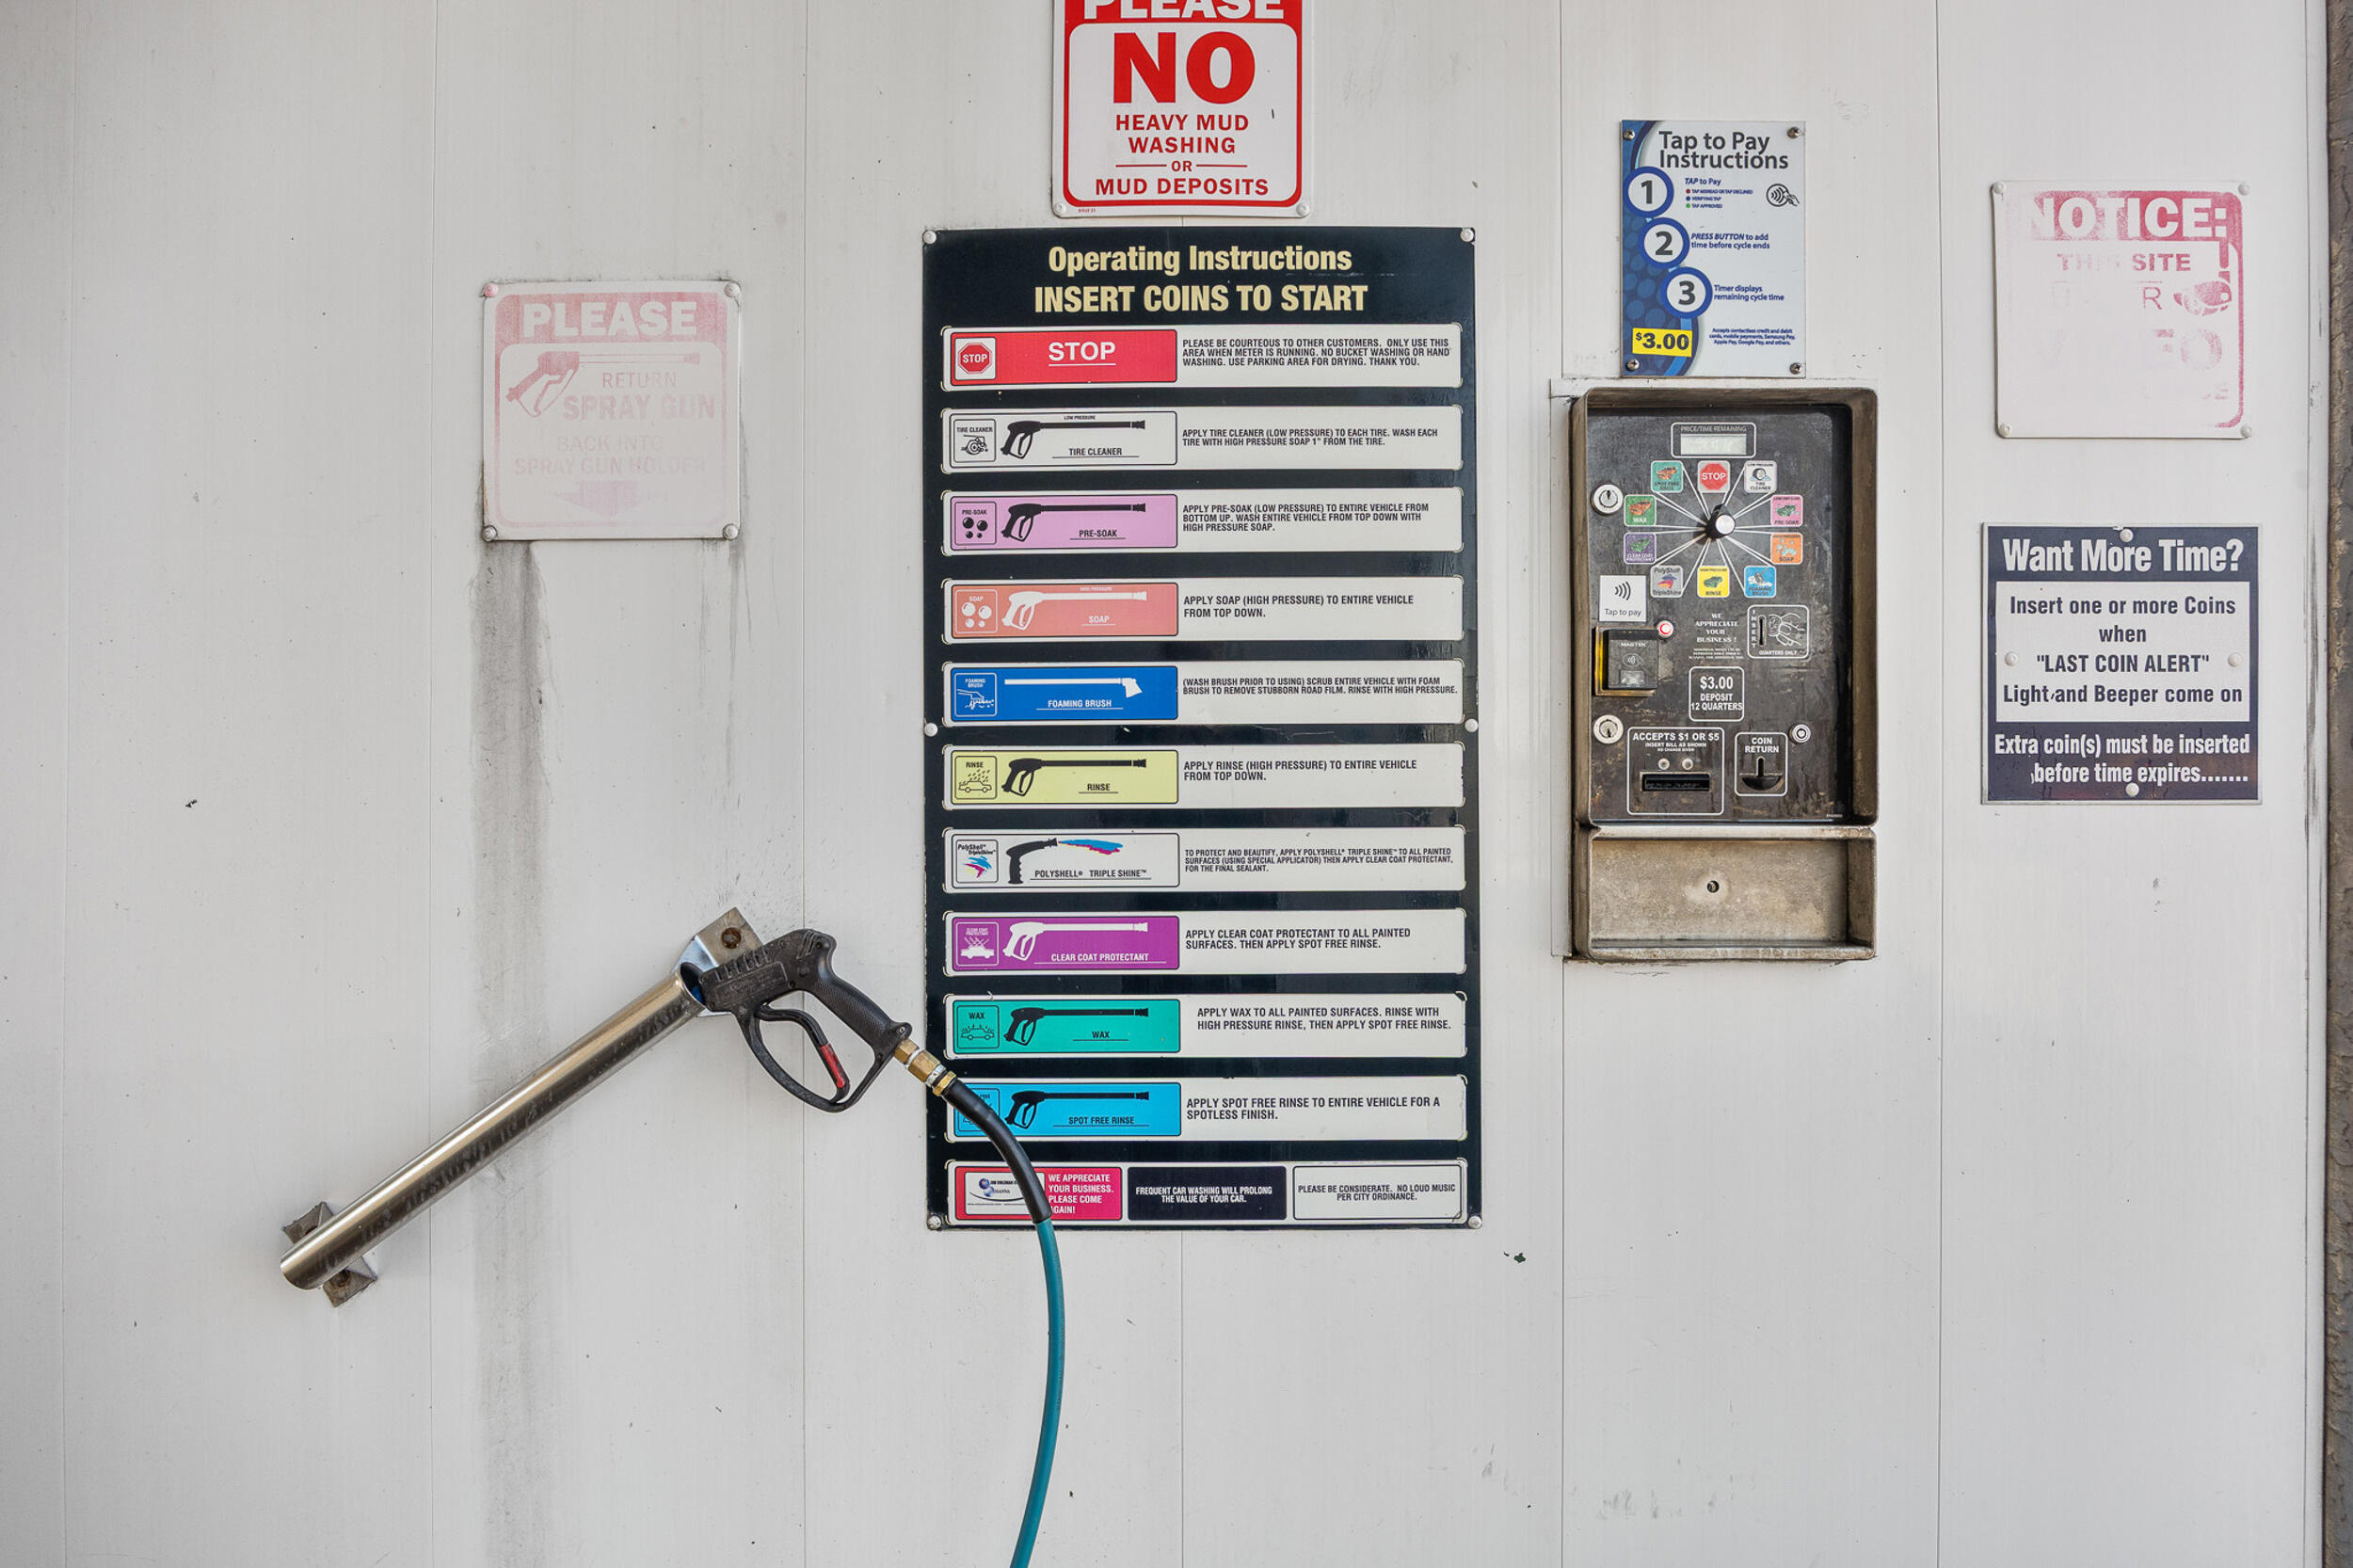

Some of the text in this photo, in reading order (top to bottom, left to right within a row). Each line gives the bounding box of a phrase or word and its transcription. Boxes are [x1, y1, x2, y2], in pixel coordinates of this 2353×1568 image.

[1113, 31, 1255, 104] NO
[1116, 115, 1248, 131] HEAVY MUD
[1129, 137, 1235, 153] WASHING
[1658, 131, 1769, 155] Tap to Pay
[1171, 161, 1192, 171] OR
[1660, 151, 1788, 169] Instructions
[1096, 178, 1268, 196] MUD DEPOSITS
[1708, 178, 1721, 186] Pay
[1641, 181, 1652, 204] 1
[1656, 232, 1673, 255] 2
[1734, 242, 1751, 250] cycle
[1048, 245, 1352, 277] Operating Instructions
[2133, 254, 2190, 271] SITE
[1035, 284, 1369, 312] INSERT COINS TO START
[1679, 280, 1695, 305] 3
[1714, 294, 1749, 302] remaining
[522, 301, 696, 337] PLEASE
[1636, 332, 1689, 350] $3.00
[963, 352, 988, 364] STOP
[1048, 342, 1115, 360] STOP
[602, 372, 677, 388] RETURN
[564, 395, 715, 421] SPRAY GUN
[2003, 538, 2244, 572] Want More Time?
[1184, 595, 1413, 606] APPLY SOAP (HIGH PRESSURE) TO ENTIRE VEHICLE
[2010, 597, 2235, 614] Insert one or more Coins
[1185, 608, 1265, 617] FROM TOP DOWN.
[2099, 625, 2146, 642] when
[2037, 655, 2208, 672] "LAST COIN ALERT"
[1700, 676, 1733, 690] $3.00
[1048, 699, 1112, 708] FOAMING BRUSH
[2003, 685, 2241, 706] Light and Beeper come on
[1702, 702, 1742, 711] QUARTERS
[1995, 734, 2249, 758] Extra coin(s) must be inserted
[2035, 763, 2089, 783] before
[2094, 763, 2133, 782] time
[1372, 1192, 1417, 1200] ORDINANCE.
[1051, 1206, 1076, 1214] GAIN!
